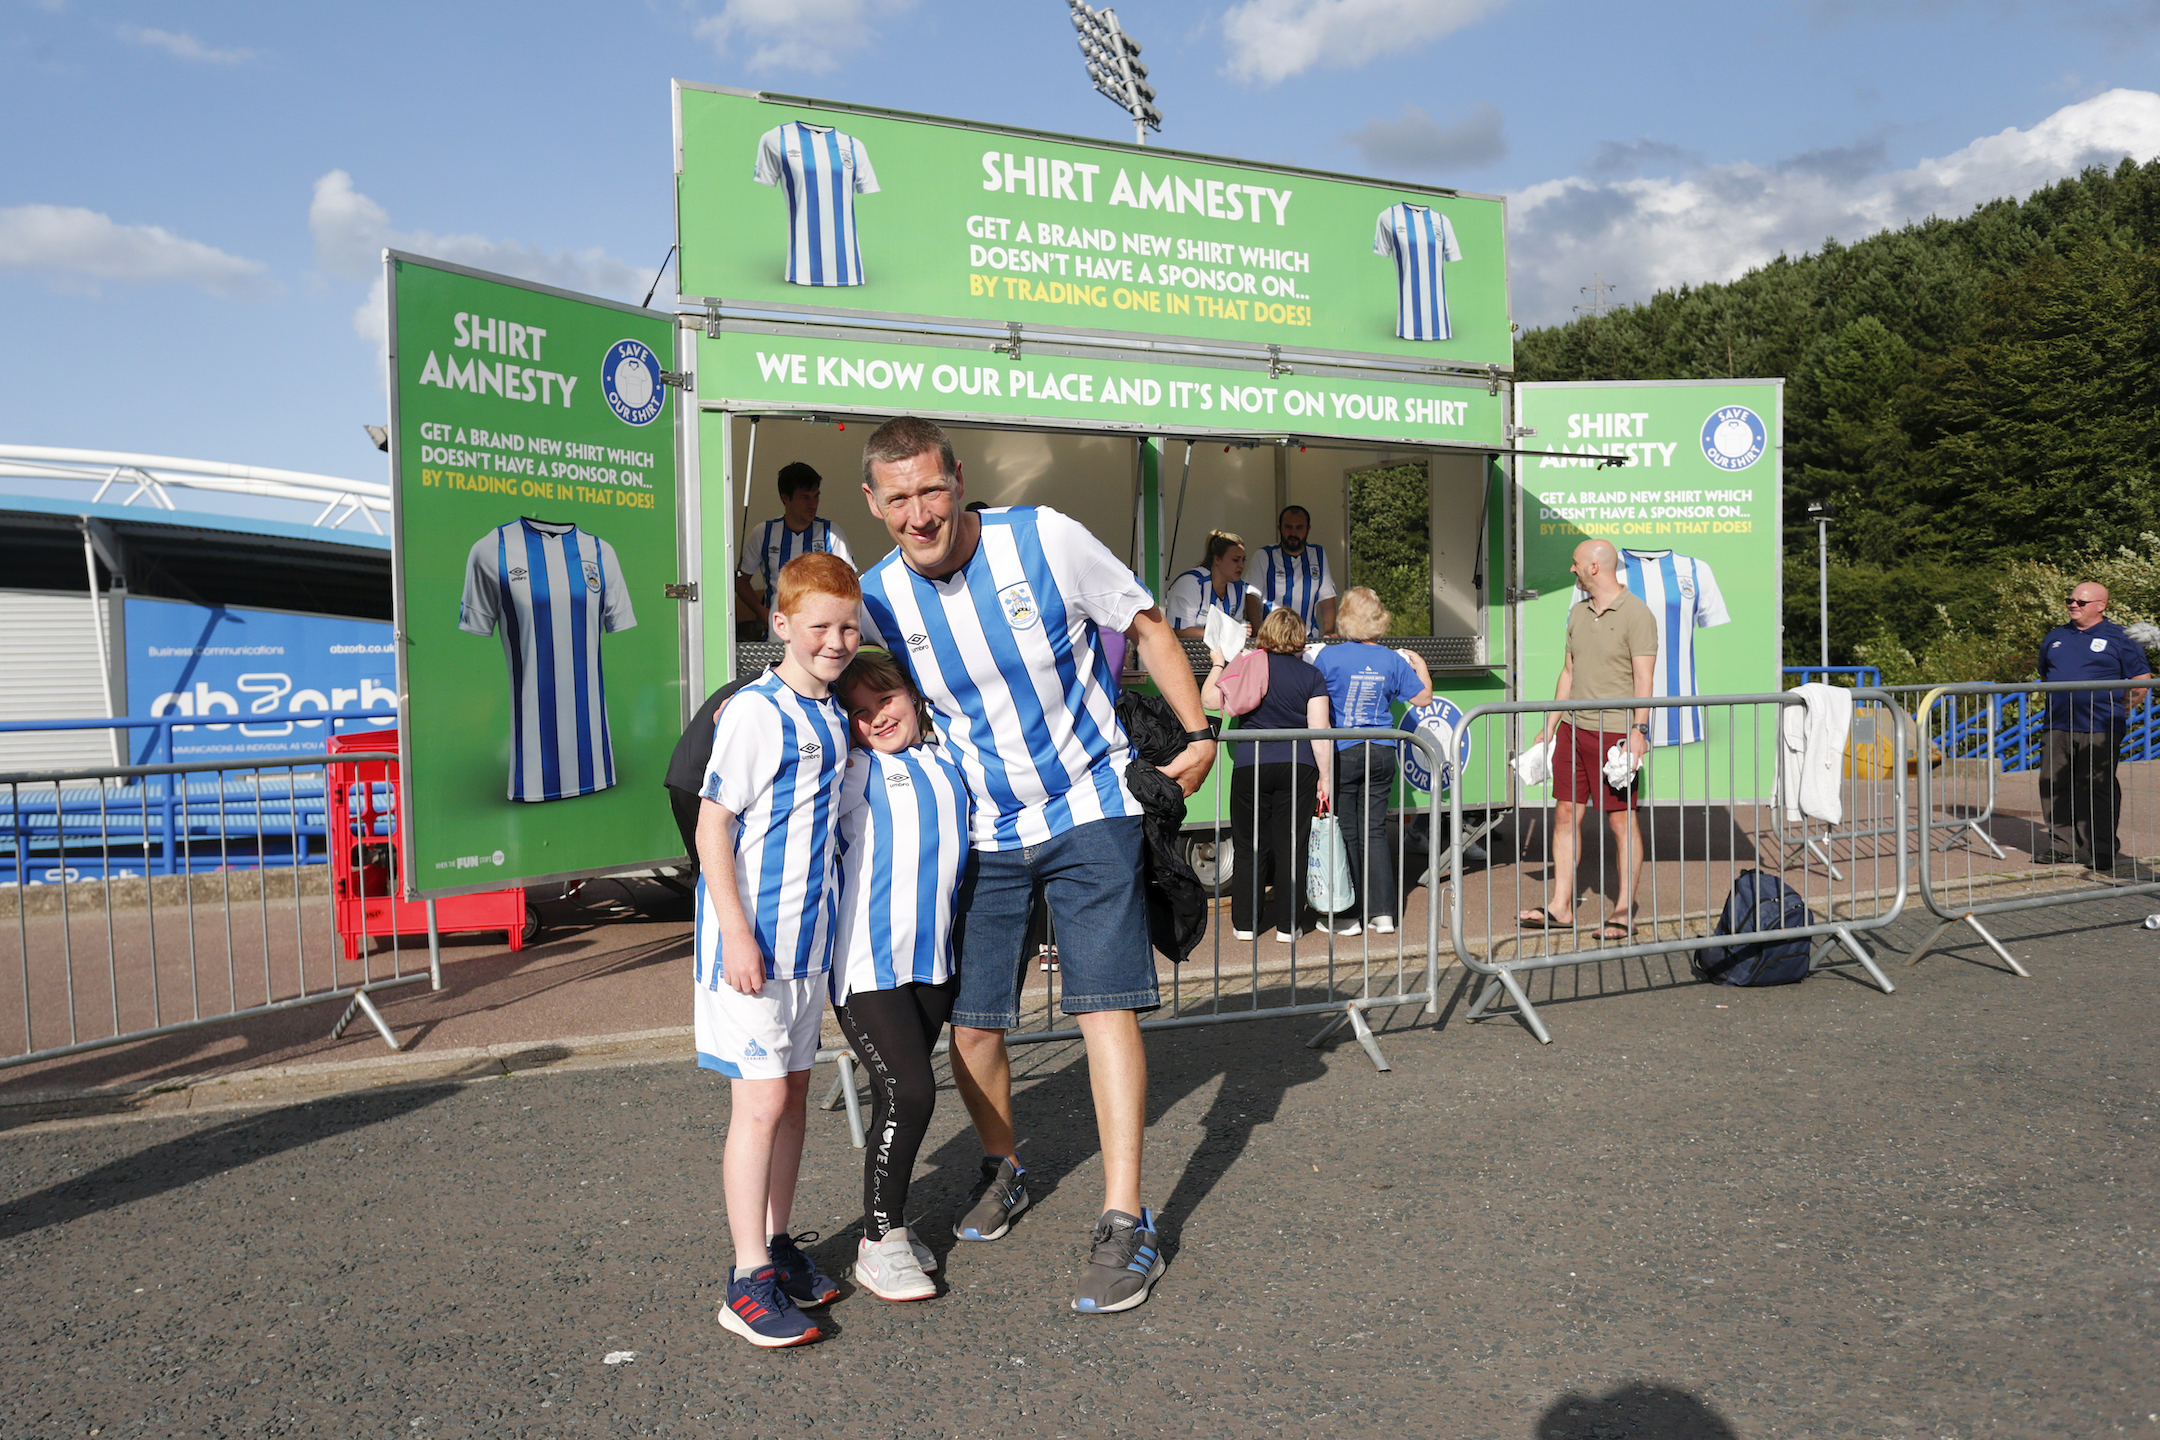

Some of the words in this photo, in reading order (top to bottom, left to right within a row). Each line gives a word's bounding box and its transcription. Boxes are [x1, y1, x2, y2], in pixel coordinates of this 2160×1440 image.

[982, 151, 1099, 202] SHIRT
[1108, 168, 1292, 226] AMNESTY
[966, 215, 1011, 241] GET
[1015, 221, 1033, 243] A
[1038, 222, 1117, 252] BRAND
[1122, 232, 1172, 257] NEW
[1177, 239, 1235, 265] SHIRT
[1239, 246, 1310, 273] WHICH
[970, 244, 1069, 276] DOESN'T
[1075, 255, 1132, 283] HAVE
[1138, 262, 1154, 284] A
[1159, 264, 1258, 295] SPONSOR
[1262, 276, 1310, 300] ON...
[969, 274, 999, 298] BY
[1003, 277, 1107, 308] TRADING
[1113, 288, 1160, 313] ONE
[1167, 293, 1190, 315] IN
[1195, 295, 1249, 321] THAT
[1254, 302, 1311, 326] DOES!
[453, 312, 546, 361] SHIRT
[618, 344, 648, 362] SAVE
[419, 350, 578, 408] AMNESTY
[756, 352, 807, 384] WE
[817, 356, 924, 391] KNOW
[932, 364, 1002, 396] OUR
[1010, 369, 1093, 402] PLACE
[1100, 376, 1161, 406] AND
[1169, 381, 1213, 410] IT'S
[1220, 385, 1278, 414] NOT
[1283, 389, 1325, 418] ON
[1330, 393, 1400, 421] YOUR
[1405, 398, 1468, 426] SHIRT
[608, 391, 630, 420] OUR
[632, 396, 660, 422] SHIRT
[1718, 408, 1749, 422] SAVE
[1568, 413, 1648, 438] SHIRT
[420, 422, 452, 444] GET
[455, 427, 467, 445] A
[471, 428, 524, 452] BRAND
[528, 437, 562, 456] NEW
[565, 442, 604, 462] SHIRT
[607, 448, 654, 468] WHICH
[1539, 442, 1678, 468] AMNESTY
[1707, 447, 1730, 468] OUR
[1730, 445, 1761, 469] SHIRT
[421, 445, 490, 470] DOESN'T
[494, 454, 534, 476] HAVE
[537, 459, 548, 477] A
[551, 461, 618, 485] SPONSOR
[620, 470, 653, 489] ON...
[422, 469, 444, 487] BY
[446, 471, 517, 496] TRADING
[521, 480, 553, 499] ONE
[557, 484, 573, 501] IN
[576, 486, 612, 506] THAT
[616, 491, 654, 509] DOES!
[1539, 492, 1564, 504] GET
[1567, 492, 1577, 504] A
[1580, 491, 1627, 504] BRAND
[1630, 491, 1662, 503] NEW
[1664, 490, 1701, 502] SHIRT
[1704, 489, 1752, 502] WHICH
[1540, 507, 1597, 520] DOESN'T
[1600, 507, 1635, 519] HAVE
[1638, 507, 1648, 519] A
[1650, 505, 1715, 518] SPONSOR
[1717, 505, 1750, 517] ON...
[1540, 523, 1556, 535] BY
[1559, 523, 1619, 534] TRADING
[1622, 522, 1652, 534] ONE
[1656, 522, 1671, 534] IN
[1674, 521, 1710, 533] THAT
[1713, 521, 1752, 533] DOES!
[149, 646, 193, 657] Business
[197, 645, 284, 655] Communications
[330, 644, 395, 654] abzorb.co.uk
[1416, 701, 1451, 720] SAVE
[1405, 760, 1428, 787] OUR
[457, 855, 478, 869] FUN
[858, 1032, 888, 1074] LOVE
[882, 1076, 898, 1119] love
[873, 1165, 889, 1205] love
